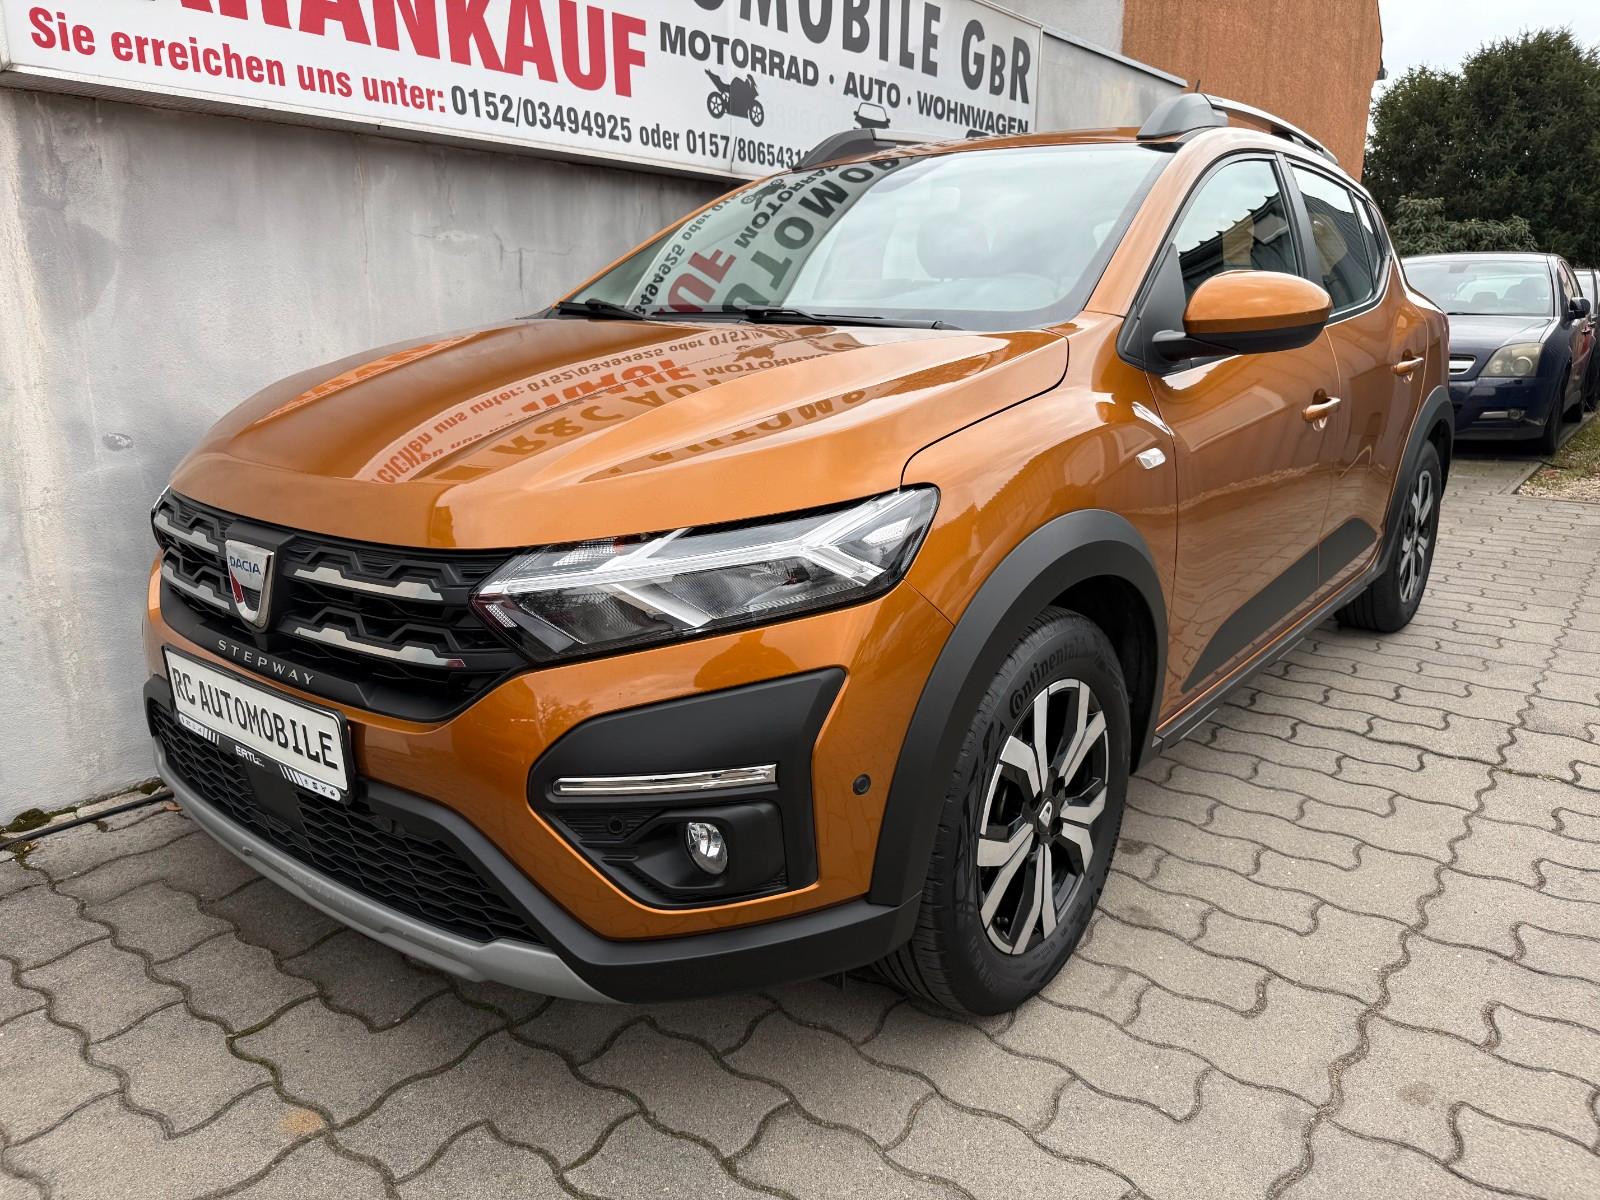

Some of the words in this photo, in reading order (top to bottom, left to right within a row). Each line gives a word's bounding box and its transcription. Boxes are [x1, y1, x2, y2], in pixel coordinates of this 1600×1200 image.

[30, 6, 95, 56] Sie
[111, 31, 286, 87] erreichen
[297, 64, 352, 98] uns
[362, 76, 446, 113] unter:
[451, 85, 632, 143] 0152/03494925
[639, 123, 680, 152] oder
[686, 129, 809, 169] 0157/8065431
[660, 21, 819, 87] MOTORRAD
[843, 71, 901, 108] AUTO
[917, 90, 1029, 135] WOHNWAGEN
[229, 555, 262, 576] DACIA
[218, 639, 314, 685] STEPWAY
[171, 666, 197, 706] RC
[199, 680, 338, 771] AUTOMOBILE
